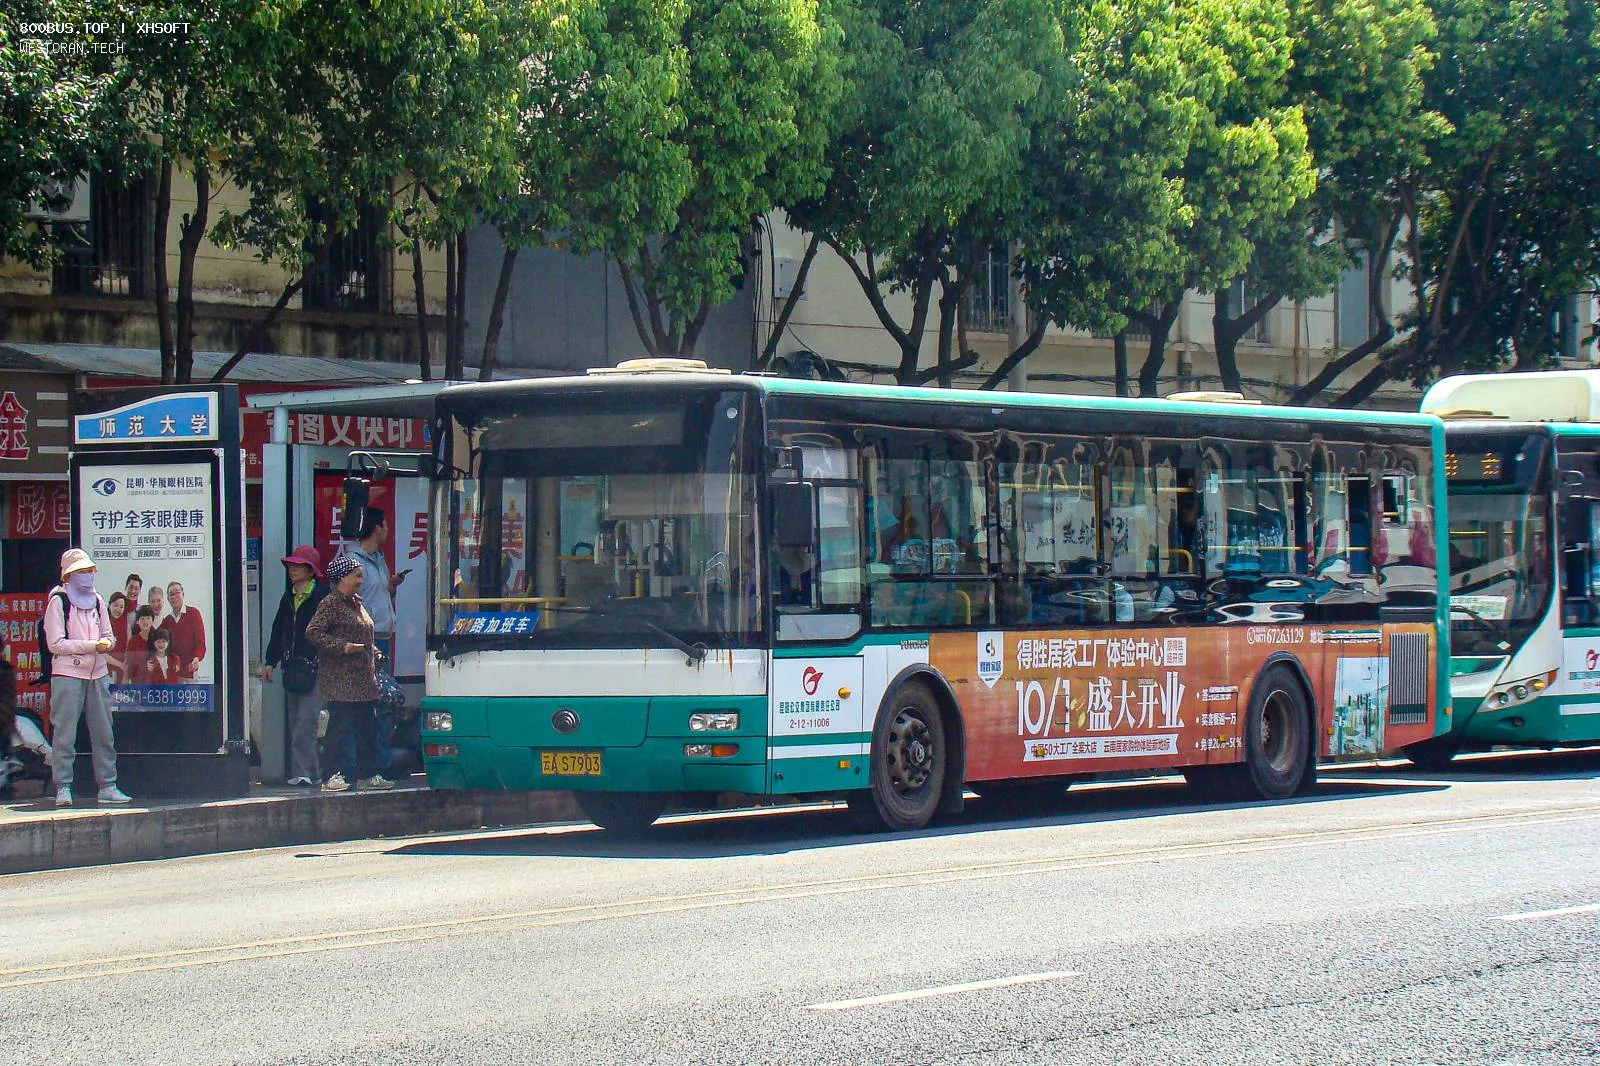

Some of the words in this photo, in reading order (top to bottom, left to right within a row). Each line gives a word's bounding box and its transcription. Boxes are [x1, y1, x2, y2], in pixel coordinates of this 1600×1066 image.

[99, 414, 207, 438] 师范大学
[91, 508, 204, 529] 守护全家眼健康
[1266, 628, 1304, 644] 67263129
[1016, 638, 1163, 670] 得胜居家工厂体验中心
[115, 690, 174, 704] 0871-6381
[177, 689, 207, 704] 9999
[1016, 677, 1071, 737] 10/1
[1086, 671, 1186, 732] 盛大开业
